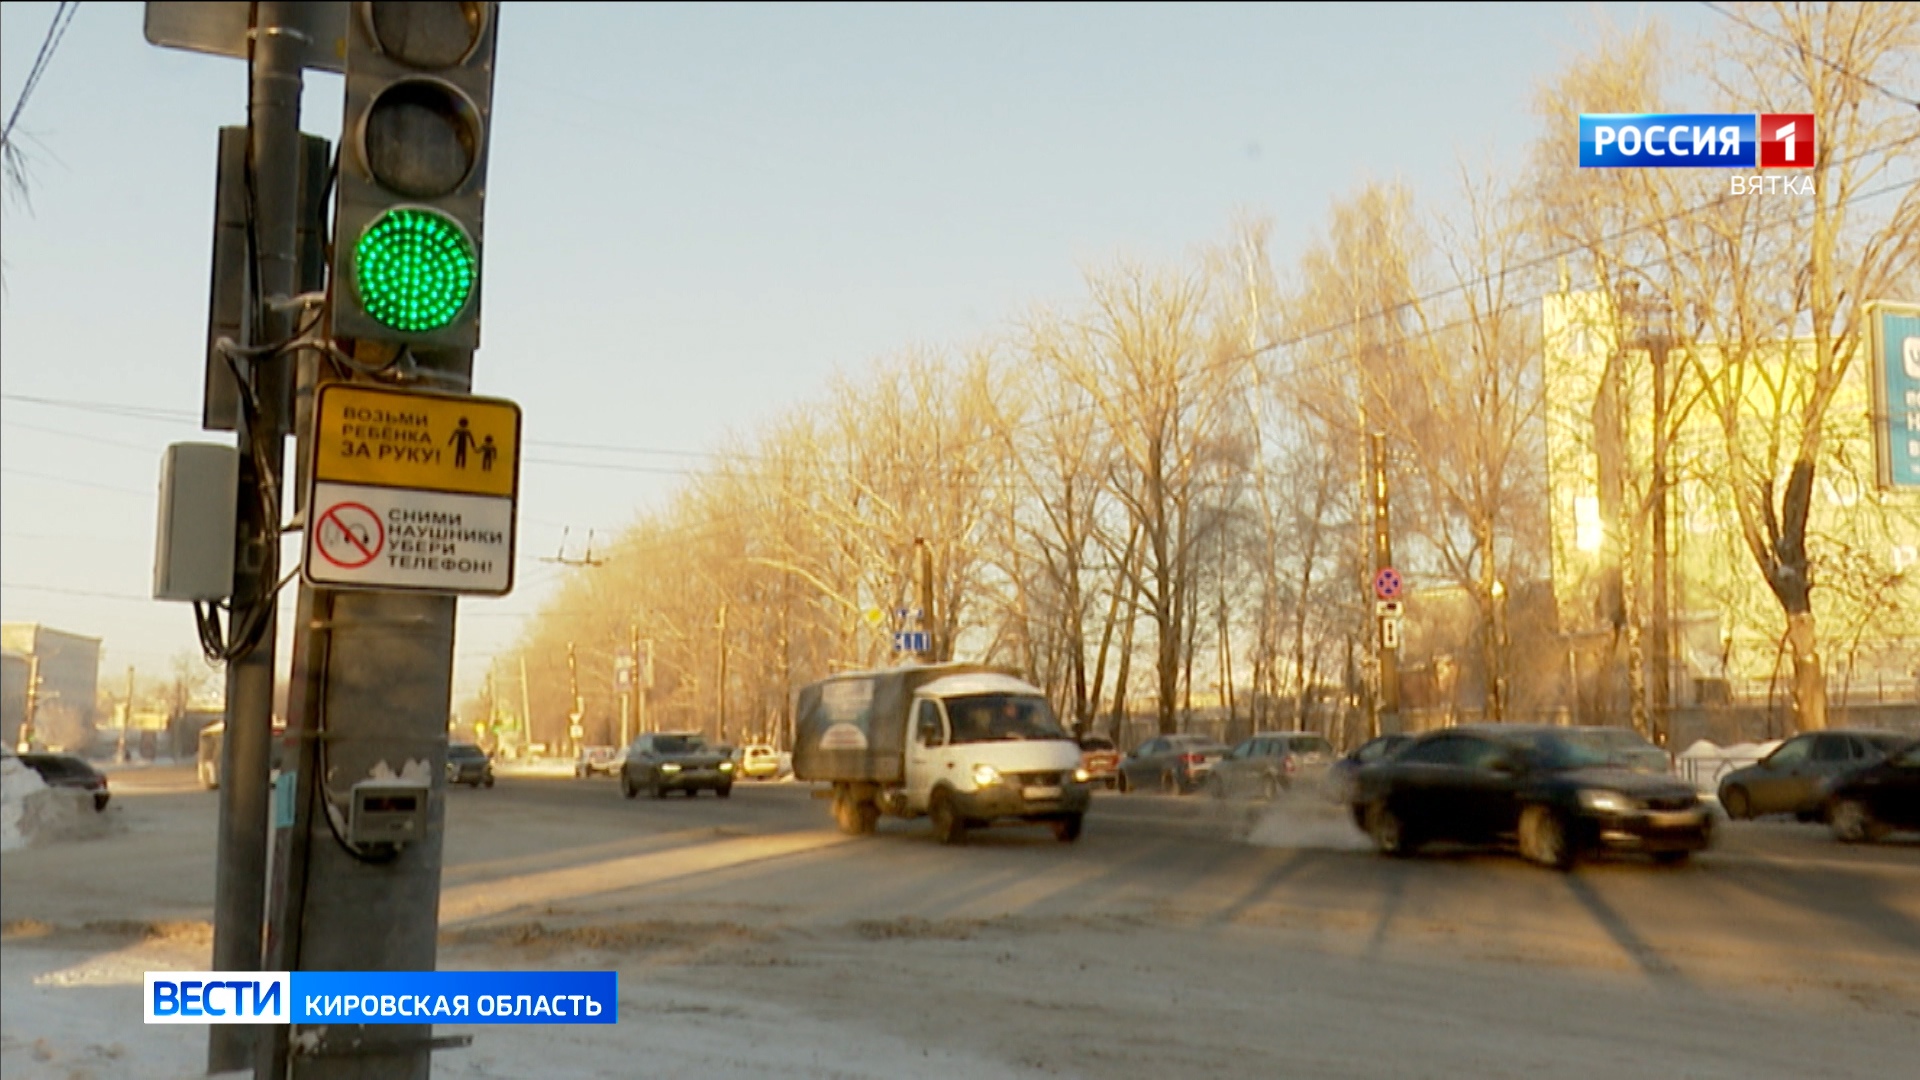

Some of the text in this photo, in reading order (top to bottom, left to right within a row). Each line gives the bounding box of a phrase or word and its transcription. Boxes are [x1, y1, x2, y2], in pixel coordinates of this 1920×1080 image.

[343, 407, 428, 427] ВОЗЬМИ
[341, 441, 440, 465] ЗА РУКУ!
[388, 508, 462, 526] СНИМИ
[388, 523, 503, 544] НАУШНИКИ
[388, 539, 455, 556] УБЕРИ
[387, 553, 492, 574] ТЕЛЕФОН!
